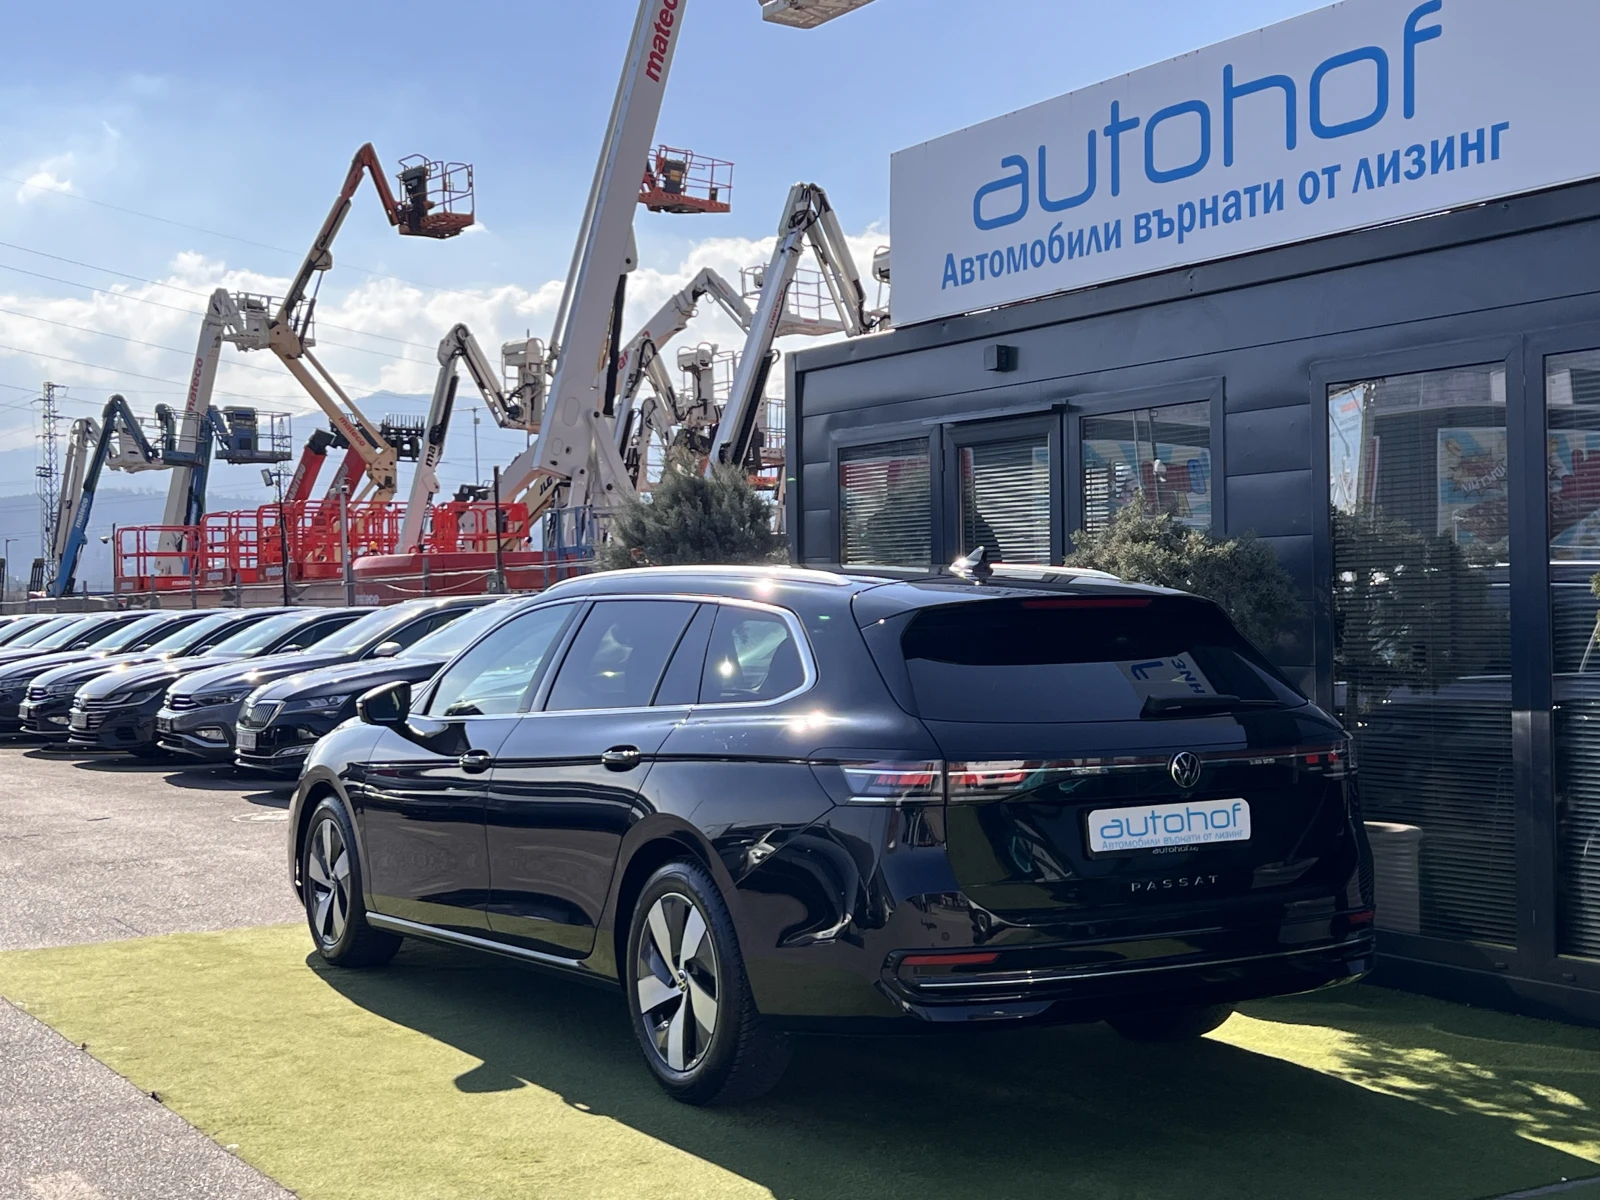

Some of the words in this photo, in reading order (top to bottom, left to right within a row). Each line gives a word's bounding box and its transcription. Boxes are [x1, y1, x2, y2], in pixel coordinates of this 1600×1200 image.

[645, 0, 679, 83] matec
[973, 0, 1443, 231] autohof
[941, 219, 1122, 290] Автомобили
[1134, 178, 1284, 245] върнати
[1298, 164, 1342, 206] от
[1352, 122, 1511, 194] лизинг
[338, 416, 366, 447] mateco
[75, 497, 89, 529] mateco
[1100, 803, 1241, 839] autohof
[1102, 838, 1160, 850] Автомобили
[1163, 834, 1200, 845] върнати
[1203, 832, 1212, 841] от
[1215, 829, 1243, 840] лизинг
[1131, 875, 1218, 892] PASSAT
